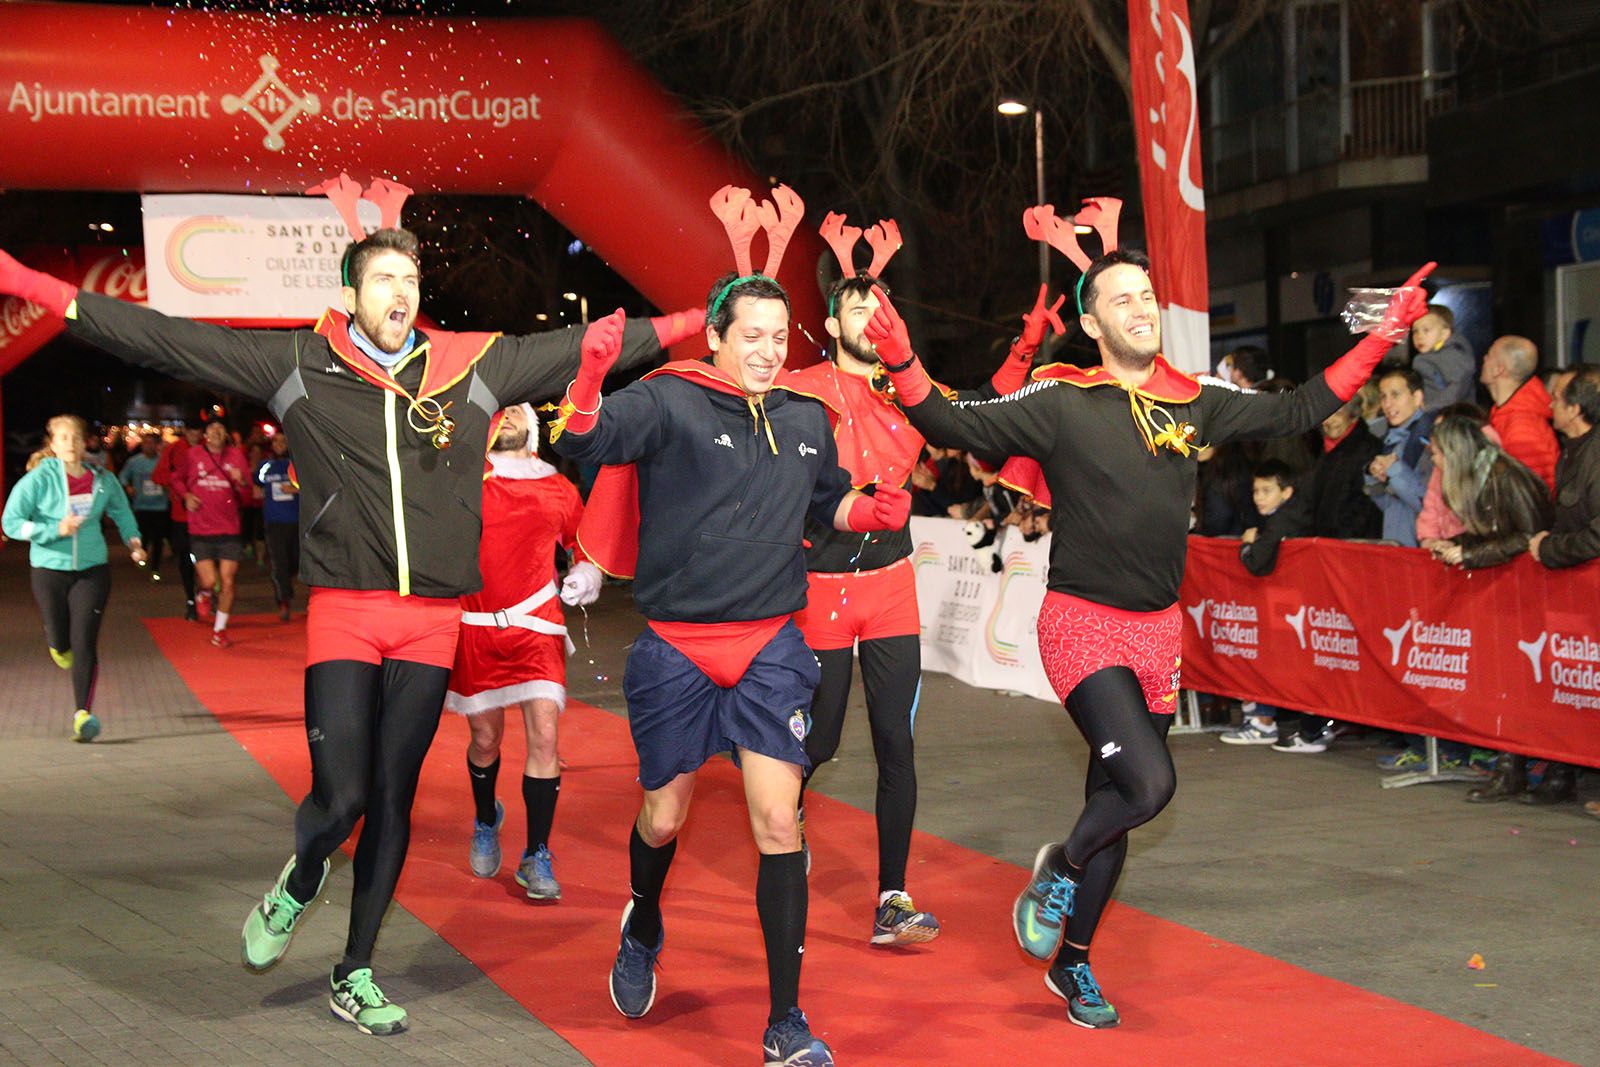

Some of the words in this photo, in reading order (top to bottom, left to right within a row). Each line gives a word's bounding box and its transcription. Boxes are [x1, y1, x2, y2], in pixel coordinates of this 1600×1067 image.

[8, 81, 211, 122] Ajuntament
[332, 88, 372, 120] de
[380, 89, 541, 127] SantCugat
[266, 225, 313, 237] SANT
[265, 257, 315, 271] CIUTAT
[282, 273, 302, 288] DE
[1206, 599, 1258, 622] Catalana
[1311, 630, 1359, 656] Occident
[1412, 620, 1472, 648] Catalana
[1407, 646, 1470, 674] Occident
[1401, 670, 1467, 692] Assegurances
